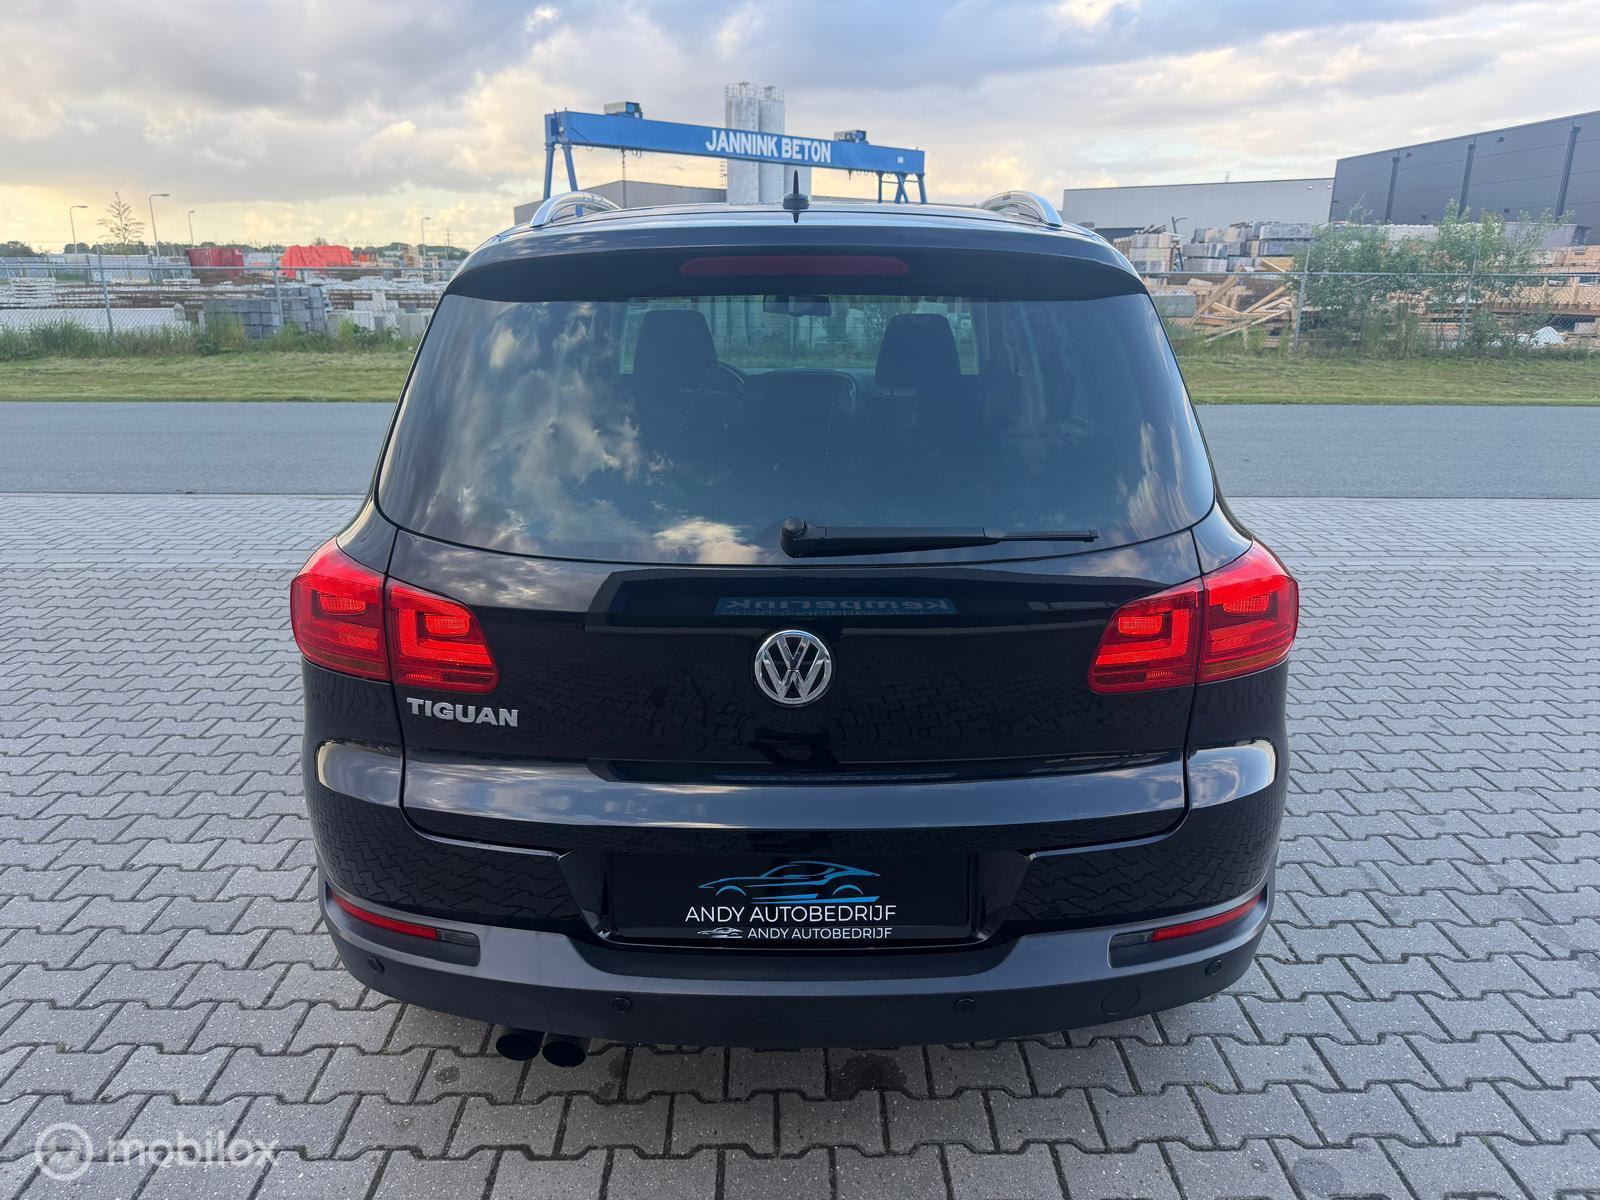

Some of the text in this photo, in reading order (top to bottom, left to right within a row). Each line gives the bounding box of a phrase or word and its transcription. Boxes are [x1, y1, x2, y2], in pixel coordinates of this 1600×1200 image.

[705, 130, 832, 163] JANNINK BETON
[406, 697, 518, 727] TIGUAN
[685, 905, 897, 923] ANDY AUTOBEDRIJF
[747, 927, 893, 940] ANDY AUTOBEDRIJF
